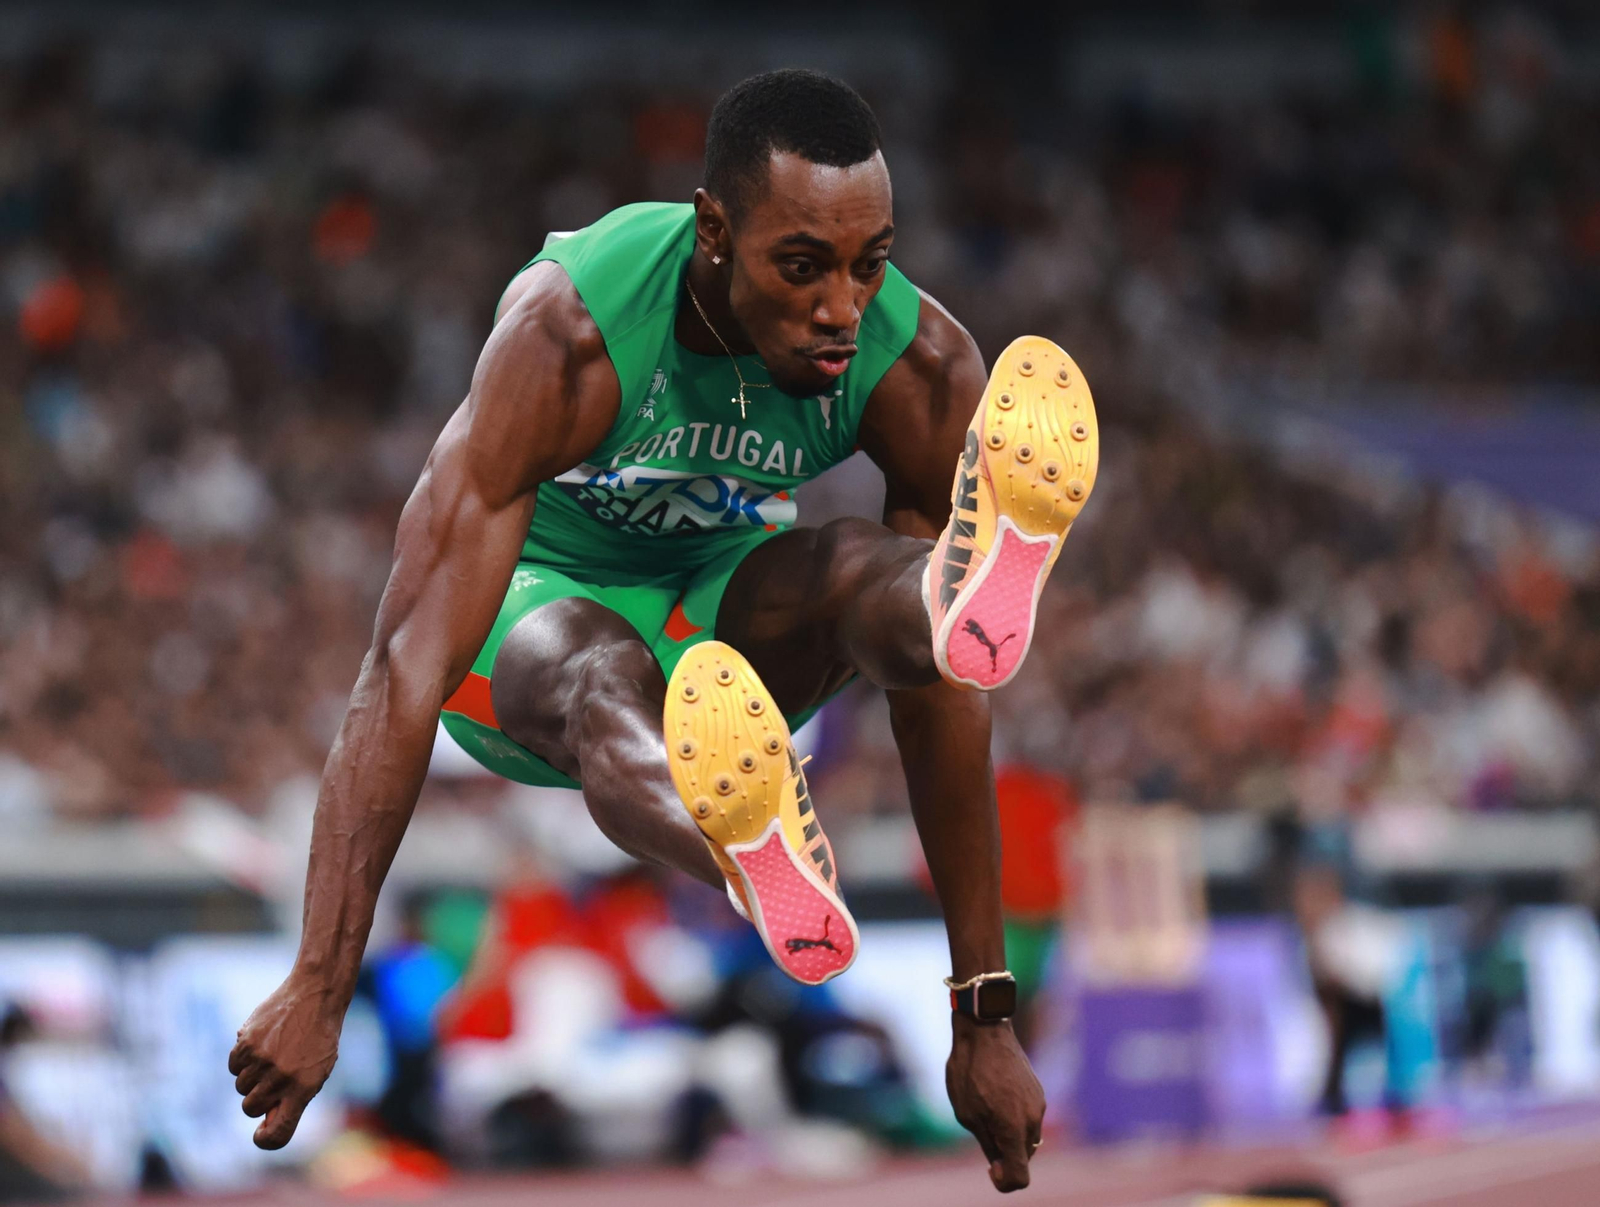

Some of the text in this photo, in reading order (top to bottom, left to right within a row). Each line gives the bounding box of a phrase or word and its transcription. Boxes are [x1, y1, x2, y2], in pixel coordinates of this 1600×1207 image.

[610, 422, 810, 477] PORTUGAL
[634, 475, 775, 526] TDK
[938, 429, 980, 614] NITRO
